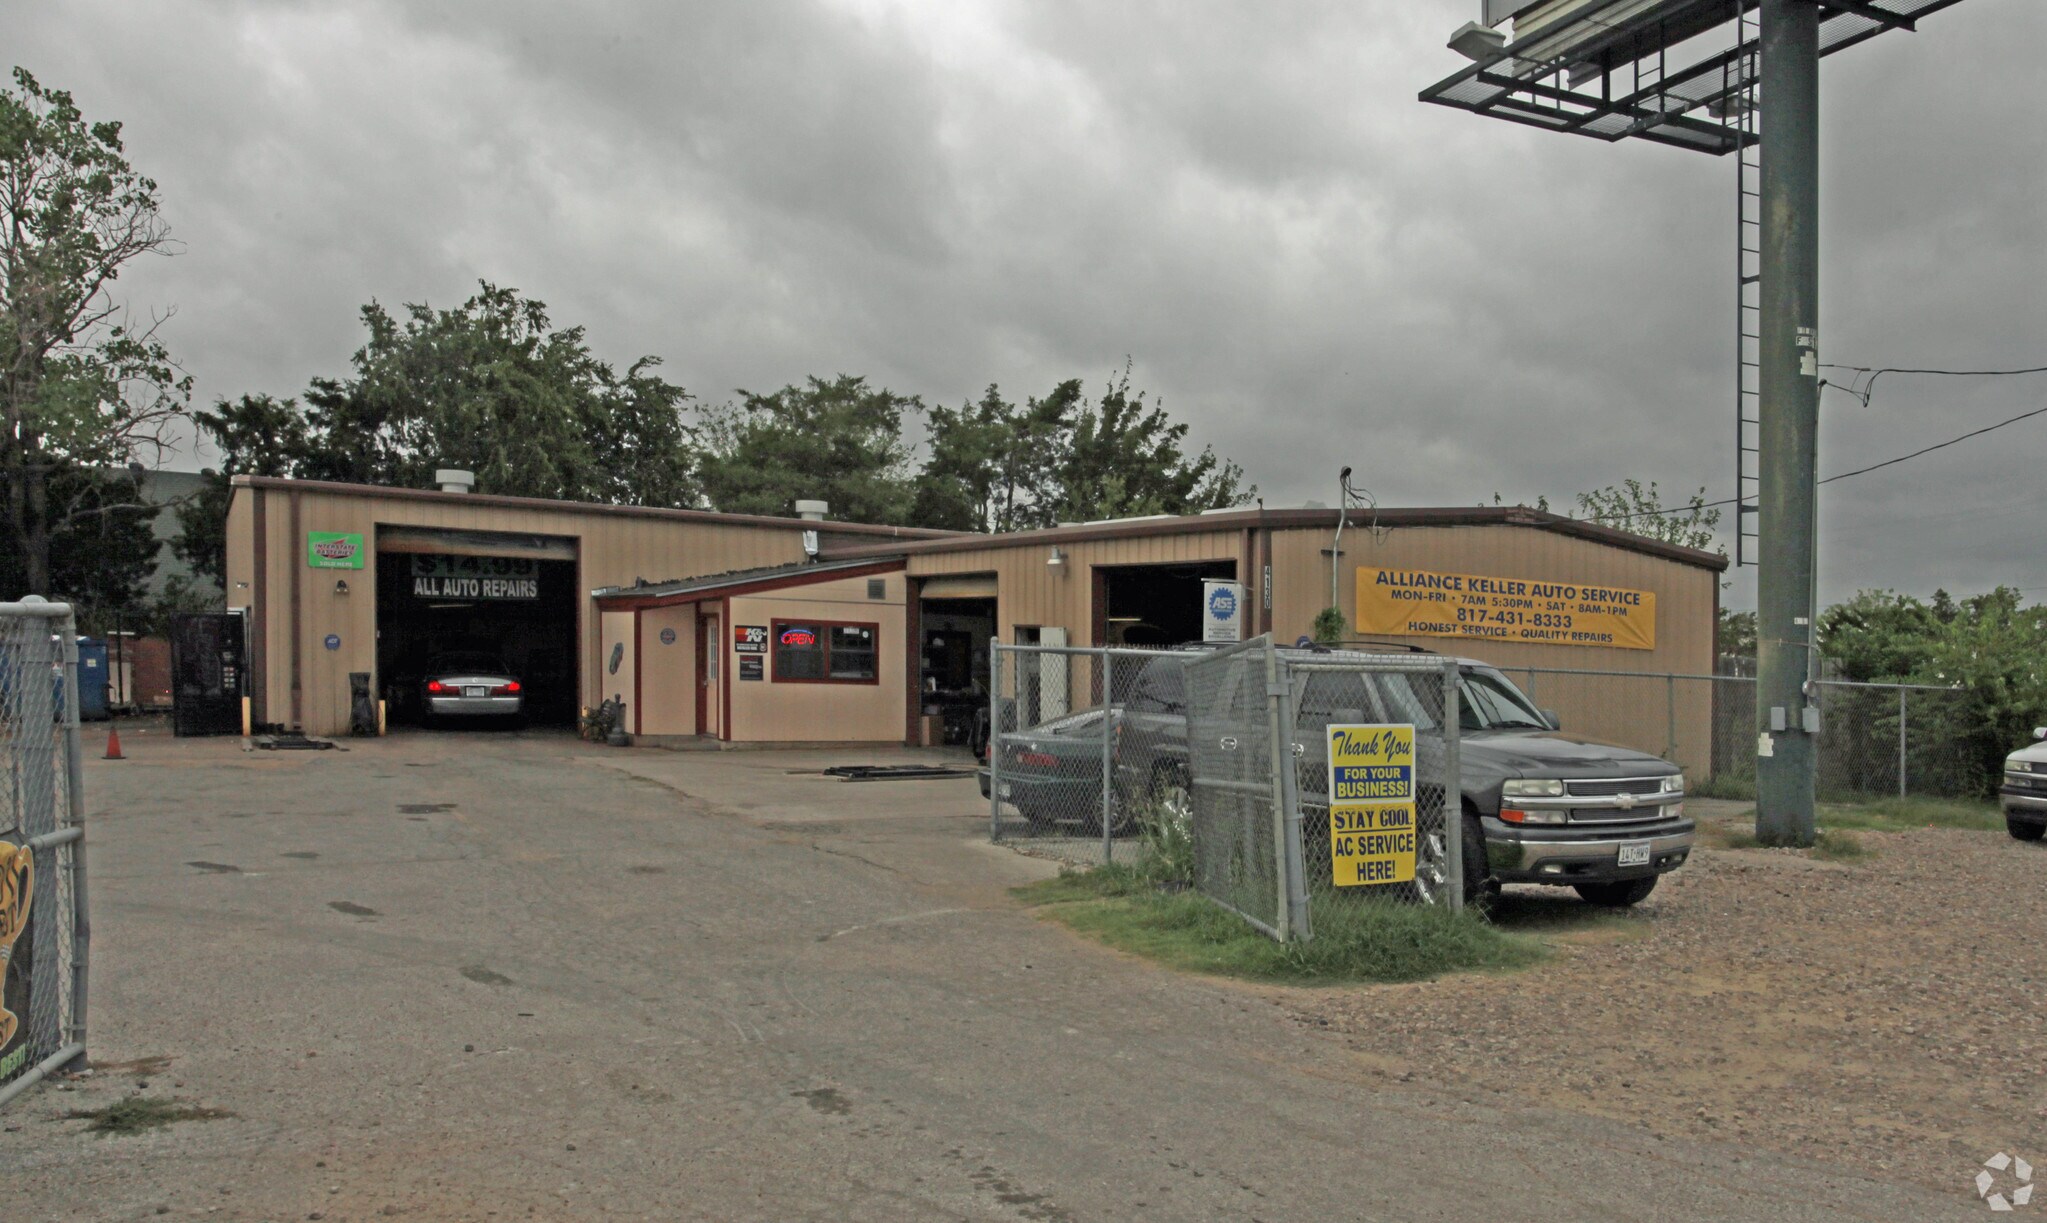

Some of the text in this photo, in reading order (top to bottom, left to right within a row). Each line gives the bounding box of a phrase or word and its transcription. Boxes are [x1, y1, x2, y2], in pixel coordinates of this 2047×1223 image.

[414, 578, 538, 597] ALL AUTO REPAIRS
[1376, 570, 1640, 606] ALLIANCE KELLER AUTO SERVICE
[1212, 597, 1233, 609] ASE
[1391, 589, 1627, 617] MON-FRI 7AM 5:30PM SAT 8AM-1PM
[1457, 607, 1572, 628] 817-431-8333
[782, 633, 815, 645] OPEN
[1408, 621, 1613, 643] HONEST SERVICE QUALITY REPAIRS
[1332, 730, 1412, 763] Thank You
[1344, 767, 1401, 780] FOR YOUR
[1337, 780, 1408, 798] BUSINESS!
[1334, 809, 1374, 829] STAY
[1335, 833, 1413, 857] AC SERVICE
[1357, 860, 1396, 881] HERE!
